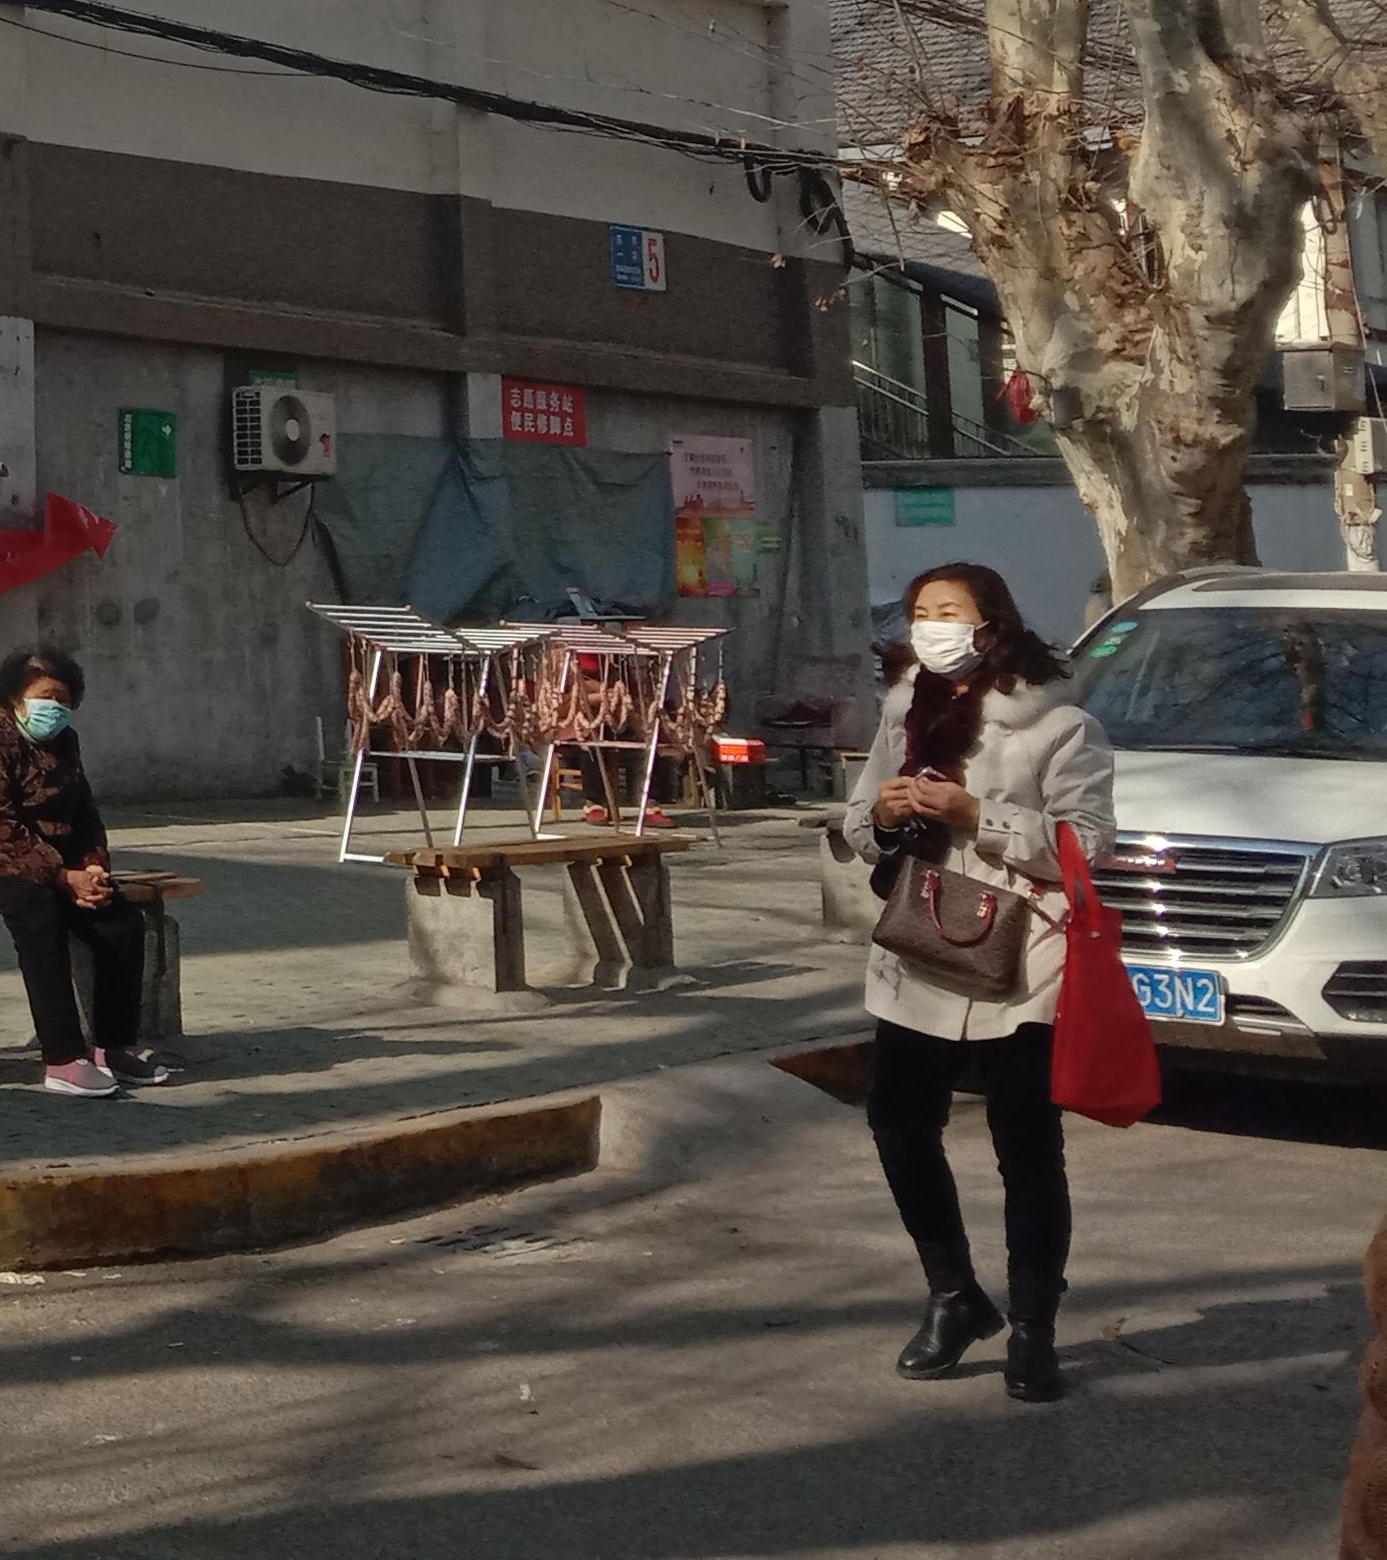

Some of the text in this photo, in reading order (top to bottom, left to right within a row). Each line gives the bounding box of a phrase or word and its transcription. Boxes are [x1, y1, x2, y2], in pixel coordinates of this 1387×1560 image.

[648, 238, 659, 283] 5
[510, 387, 573, 414] 志愿服务站
[1131, 972, 1215, 1013] G3N2
